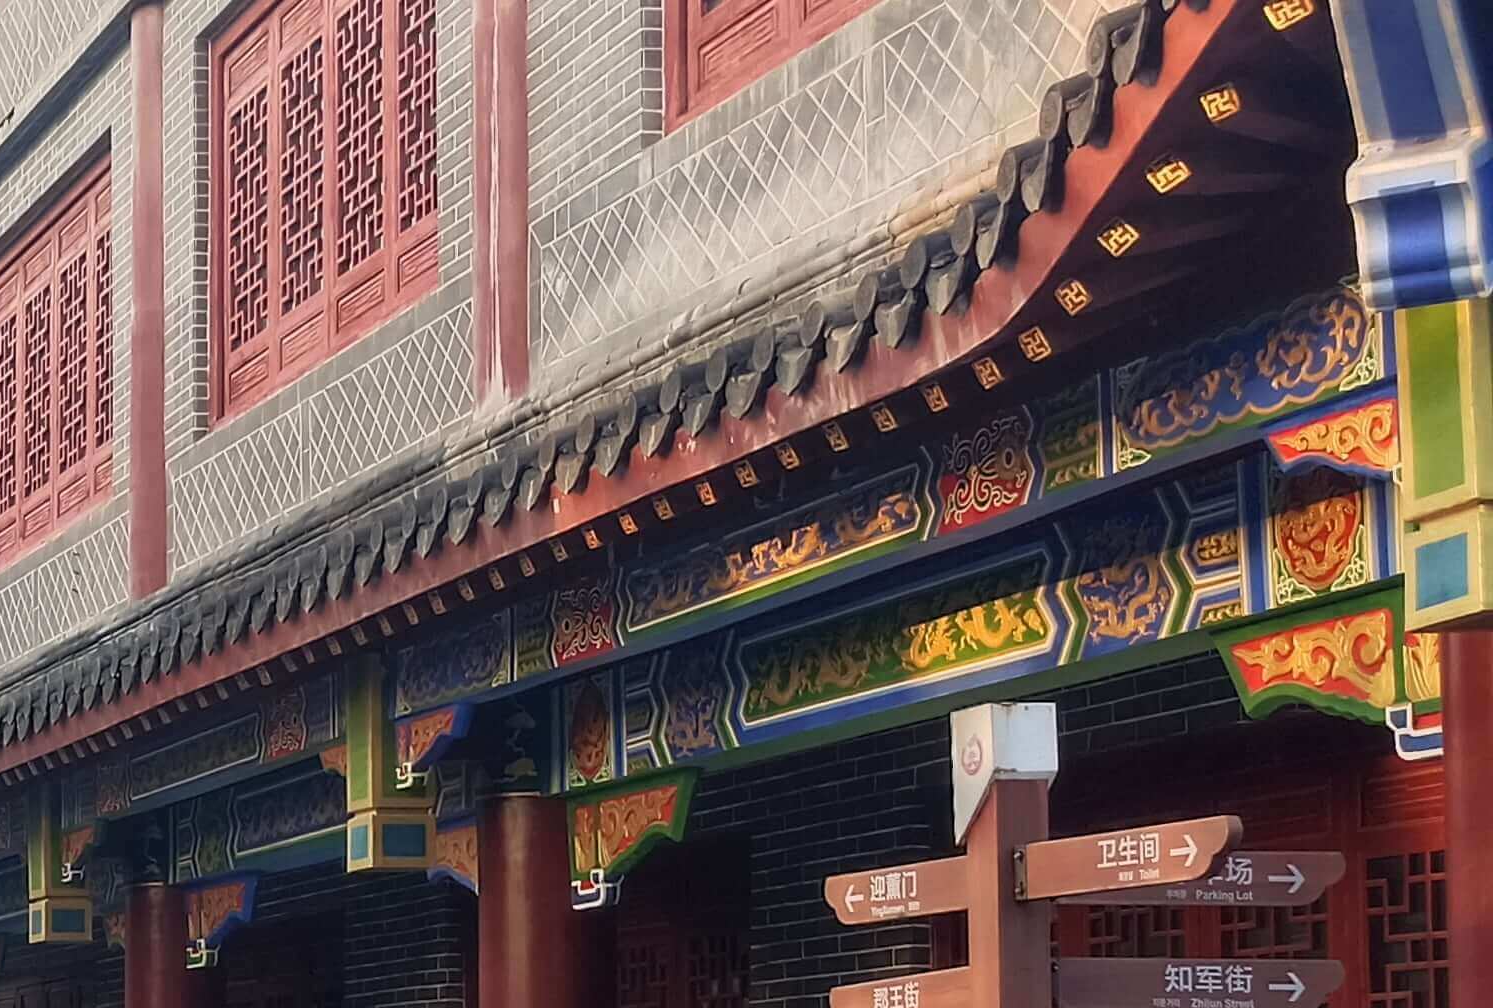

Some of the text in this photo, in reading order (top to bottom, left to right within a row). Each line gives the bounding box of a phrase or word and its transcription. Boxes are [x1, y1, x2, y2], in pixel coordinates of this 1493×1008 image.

[1096, 832, 1160, 869] 卫生间
[1195, 889, 1235, 903] Parking
[1236, 890, 1253, 901] Lot
[1164, 963, 1254, 994] 知军街
[1224, 998, 1254, 1008] Street
